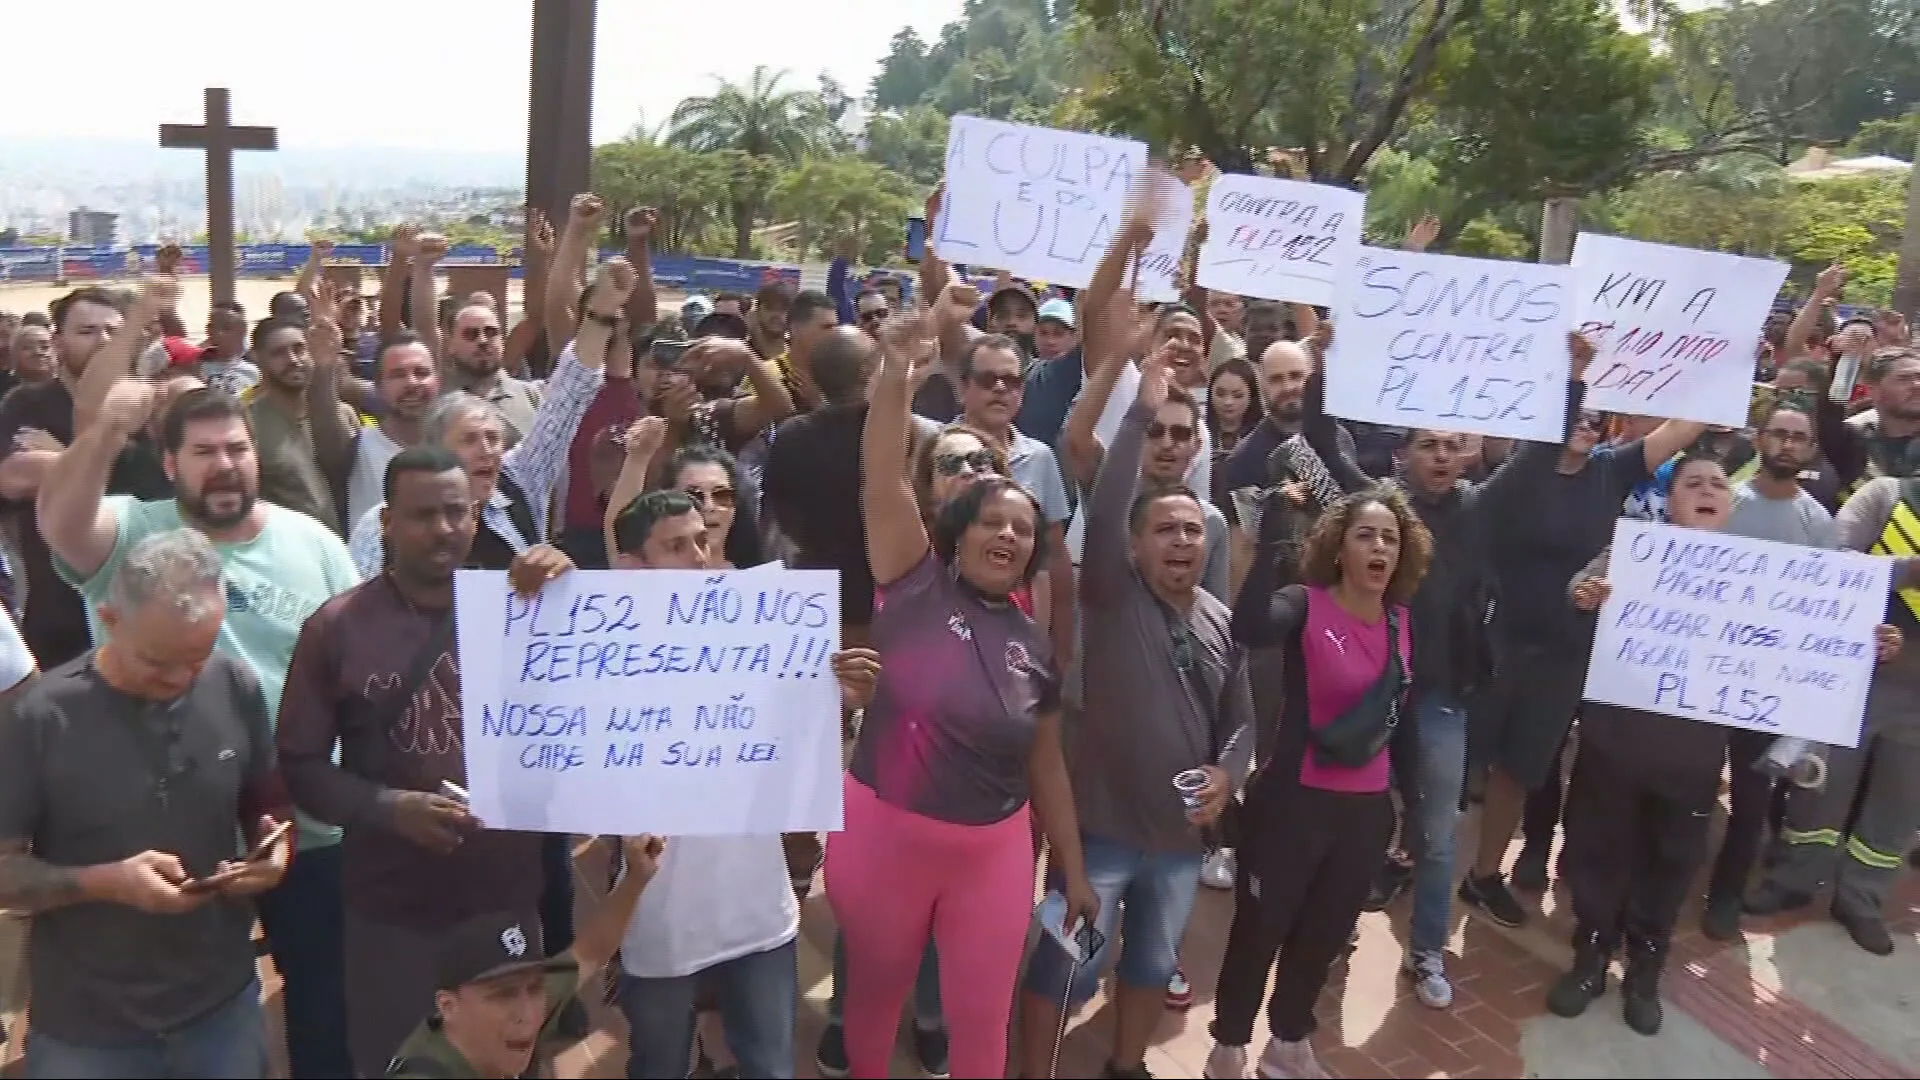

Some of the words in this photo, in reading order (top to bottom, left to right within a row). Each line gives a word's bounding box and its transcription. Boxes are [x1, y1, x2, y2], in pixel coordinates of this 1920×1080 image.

[985, 131, 1133, 193] CULPA
[939, 190, 1113, 264] LULA
[1218, 191, 1318, 228] CONTRA
[1321, 212, 1345, 234] A
[1592, 272, 1667, 312] KM
[1682, 287, 1717, 326] A
[1387, 329, 1535, 365] CONTRA
[1376, 365, 1424, 412] PL
[1630, 531, 1656, 563] O
[1660, 539, 1769, 575] MOTOCA
[1838, 567, 1878, 592] VAI
[504, 591, 551, 637] PL
[555, 592, 641, 637] 152
[665, 573, 743, 626] NÃO
[753, 588, 829, 628] NOS
[1652, 565, 1733, 602] PAGAR
[1738, 585, 1756, 607] A
[1616, 637, 1690, 671] AGORA
[1705, 654, 1757, 679] TEM
[481, 697, 588, 737] NOSSA
[605, 705, 673, 733] LUTA
[694, 692, 757, 732] NÃO
[1654, 671, 1697, 711] PL
[1708, 685, 1783, 728] 152
[519, 742, 586, 772] CABE
[604, 741, 645, 768] NA
[660, 740, 723, 768] SUA
